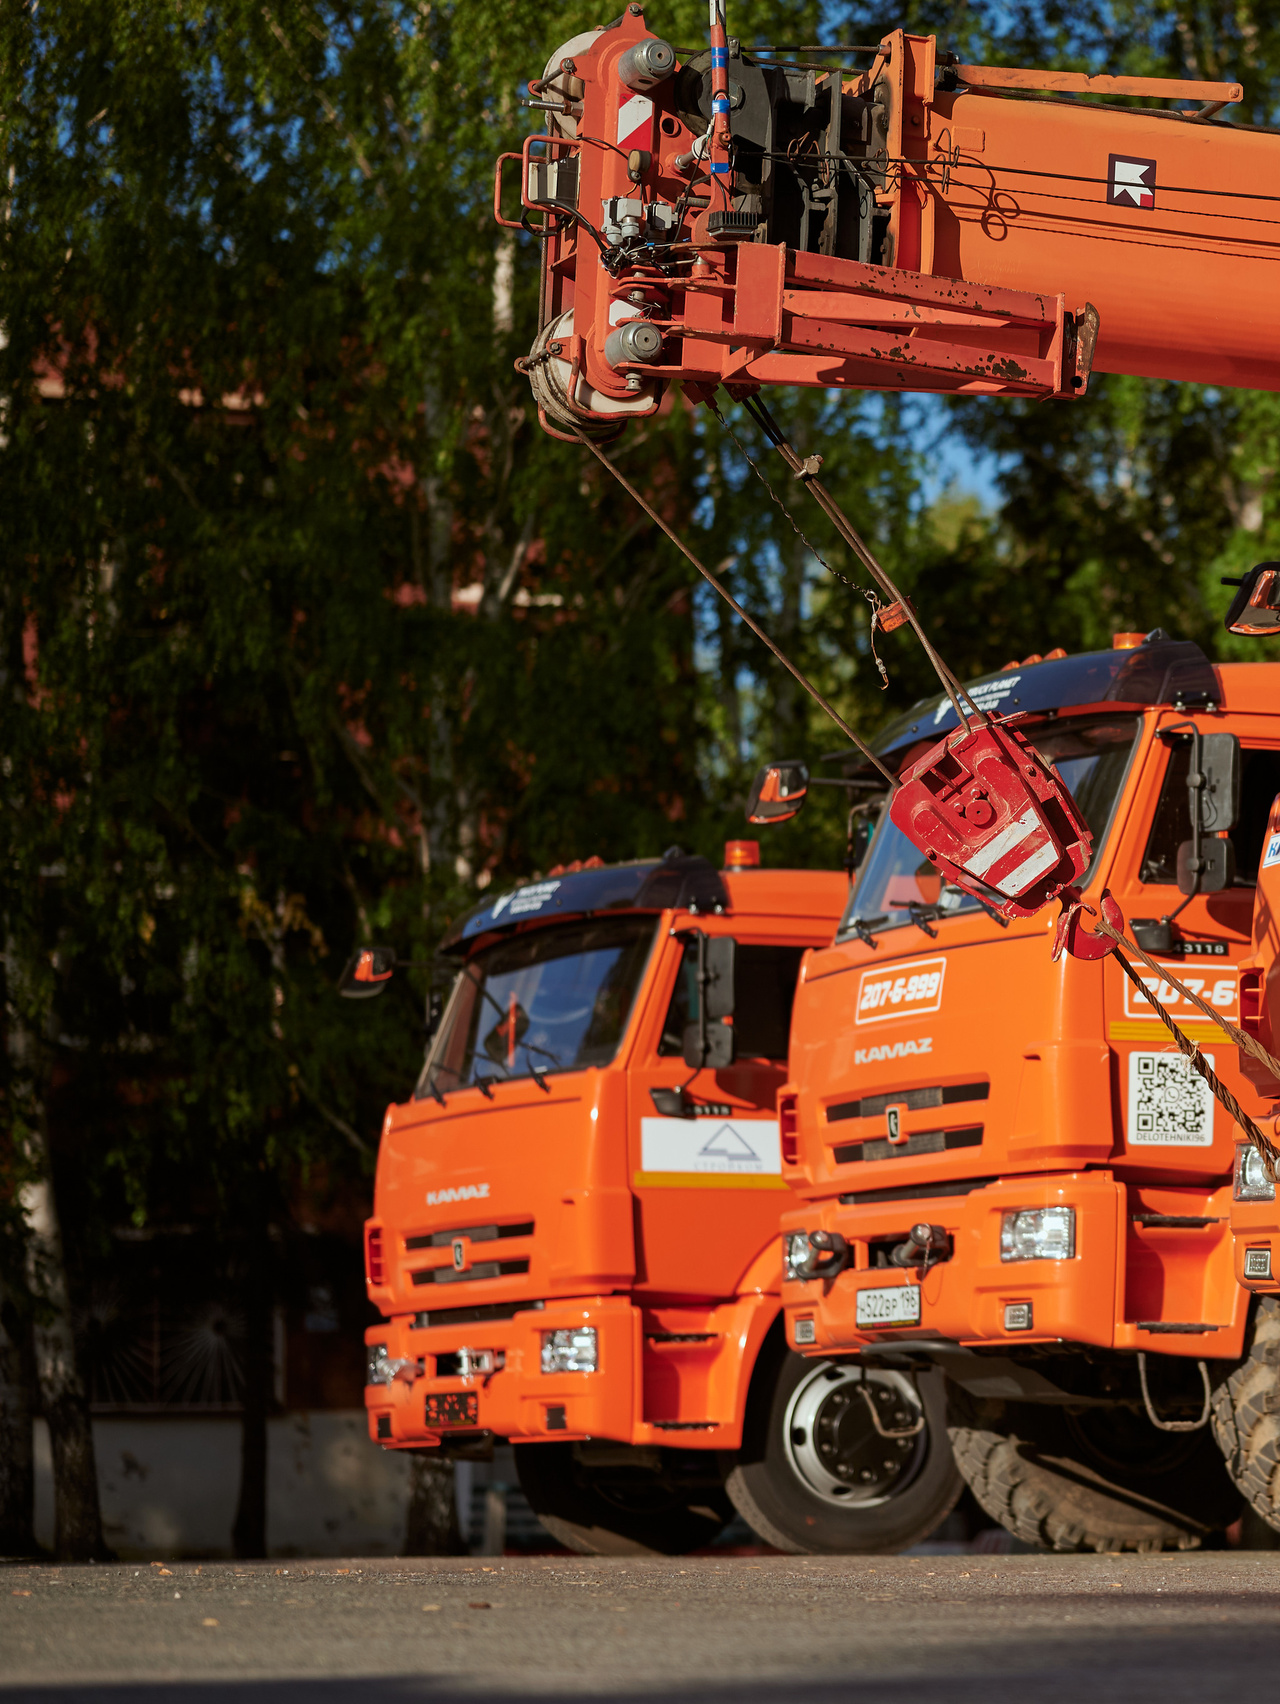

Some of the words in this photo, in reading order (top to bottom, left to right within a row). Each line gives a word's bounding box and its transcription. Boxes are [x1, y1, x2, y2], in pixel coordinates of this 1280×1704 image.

[861, 971, 941, 1011] 207-6-999
[855, 1037, 932, 1064] KAMAZ
[1135, 1132, 1205, 1143] DELOTEHNIKI96
[427, 1184, 489, 1206] KAMAZ
[901, 1290, 916, 1309] 196
